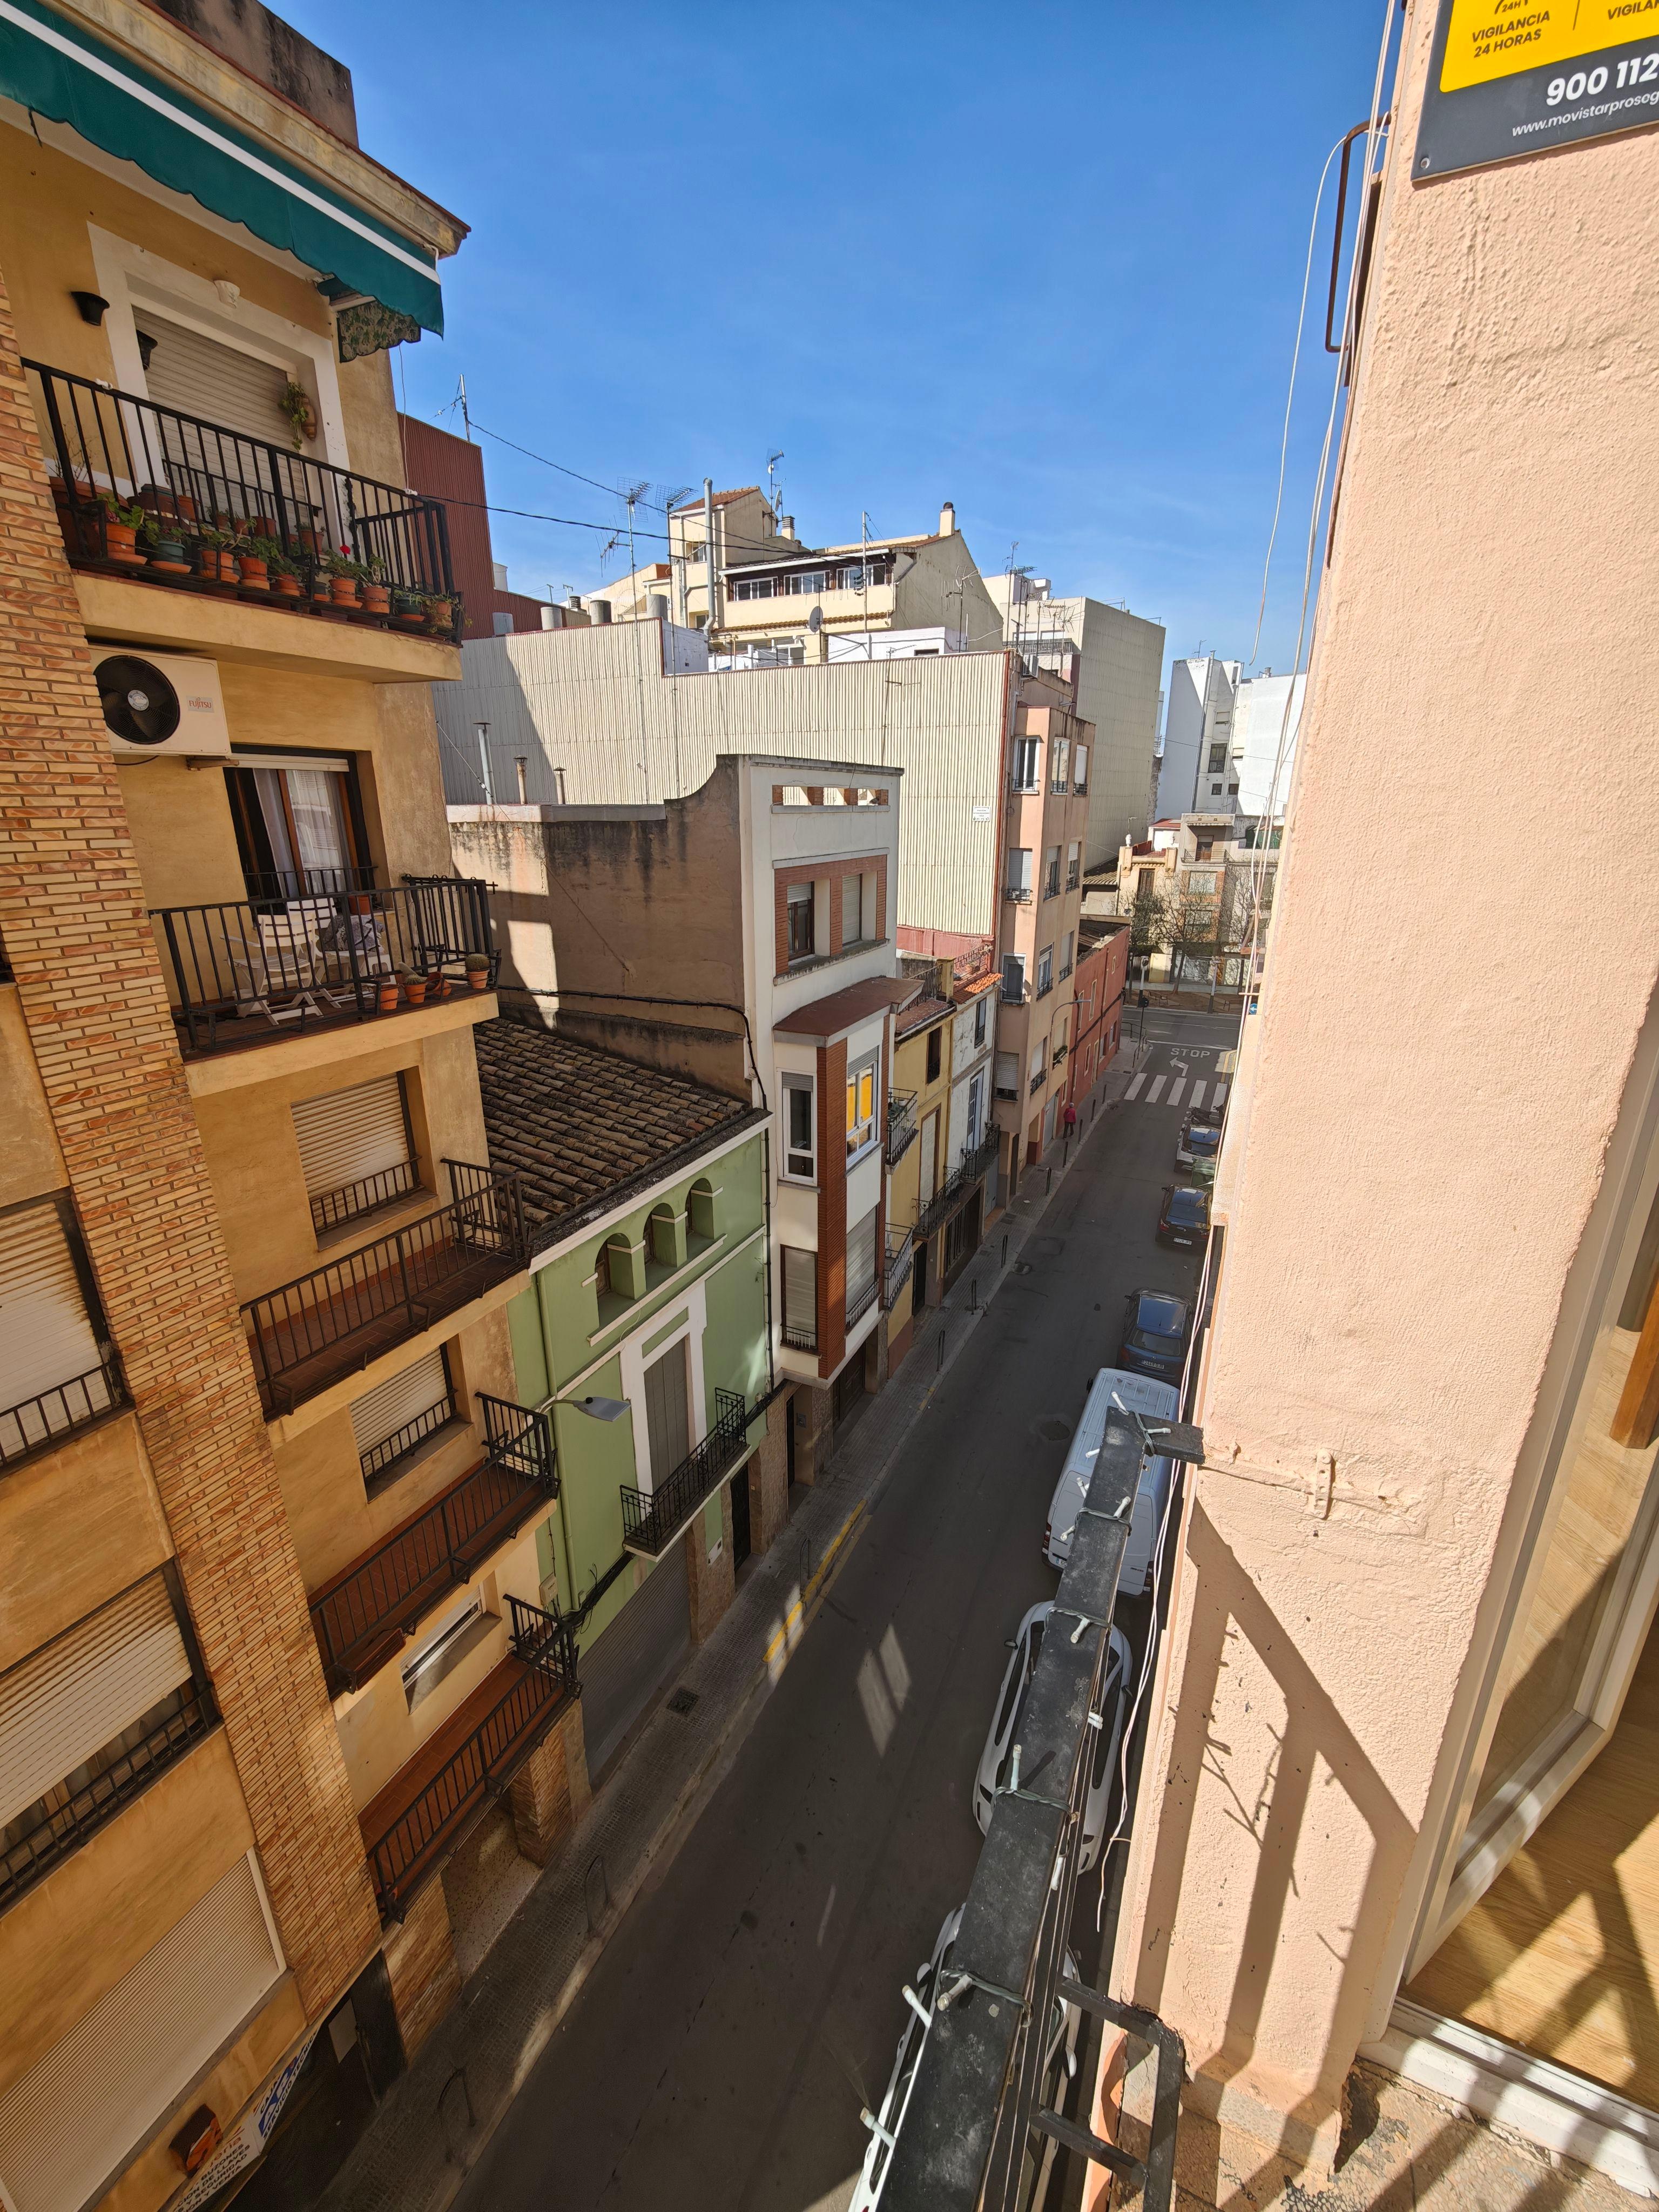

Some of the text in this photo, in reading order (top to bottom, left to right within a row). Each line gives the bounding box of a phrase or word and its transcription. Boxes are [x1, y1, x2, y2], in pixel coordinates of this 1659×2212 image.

[1472, 10, 1550, 43] VIGILANCIA
[1474, 29, 1542, 58] 24 HORAS
[1546, 53, 1659, 106] 900 112
[1512, 91, 1659, 137] www.movistarproseg
[189, 697, 211, 709] FUJITSU
[1170, 1048, 1210, 1058] STOP
[263, 2032, 316, 2139] SERVICIO TECNIC
[203, 2175, 214, 2187] DE
[217, 2144, 250, 2174] LLAVES
[212, 2166, 241, 2189] VENTA
